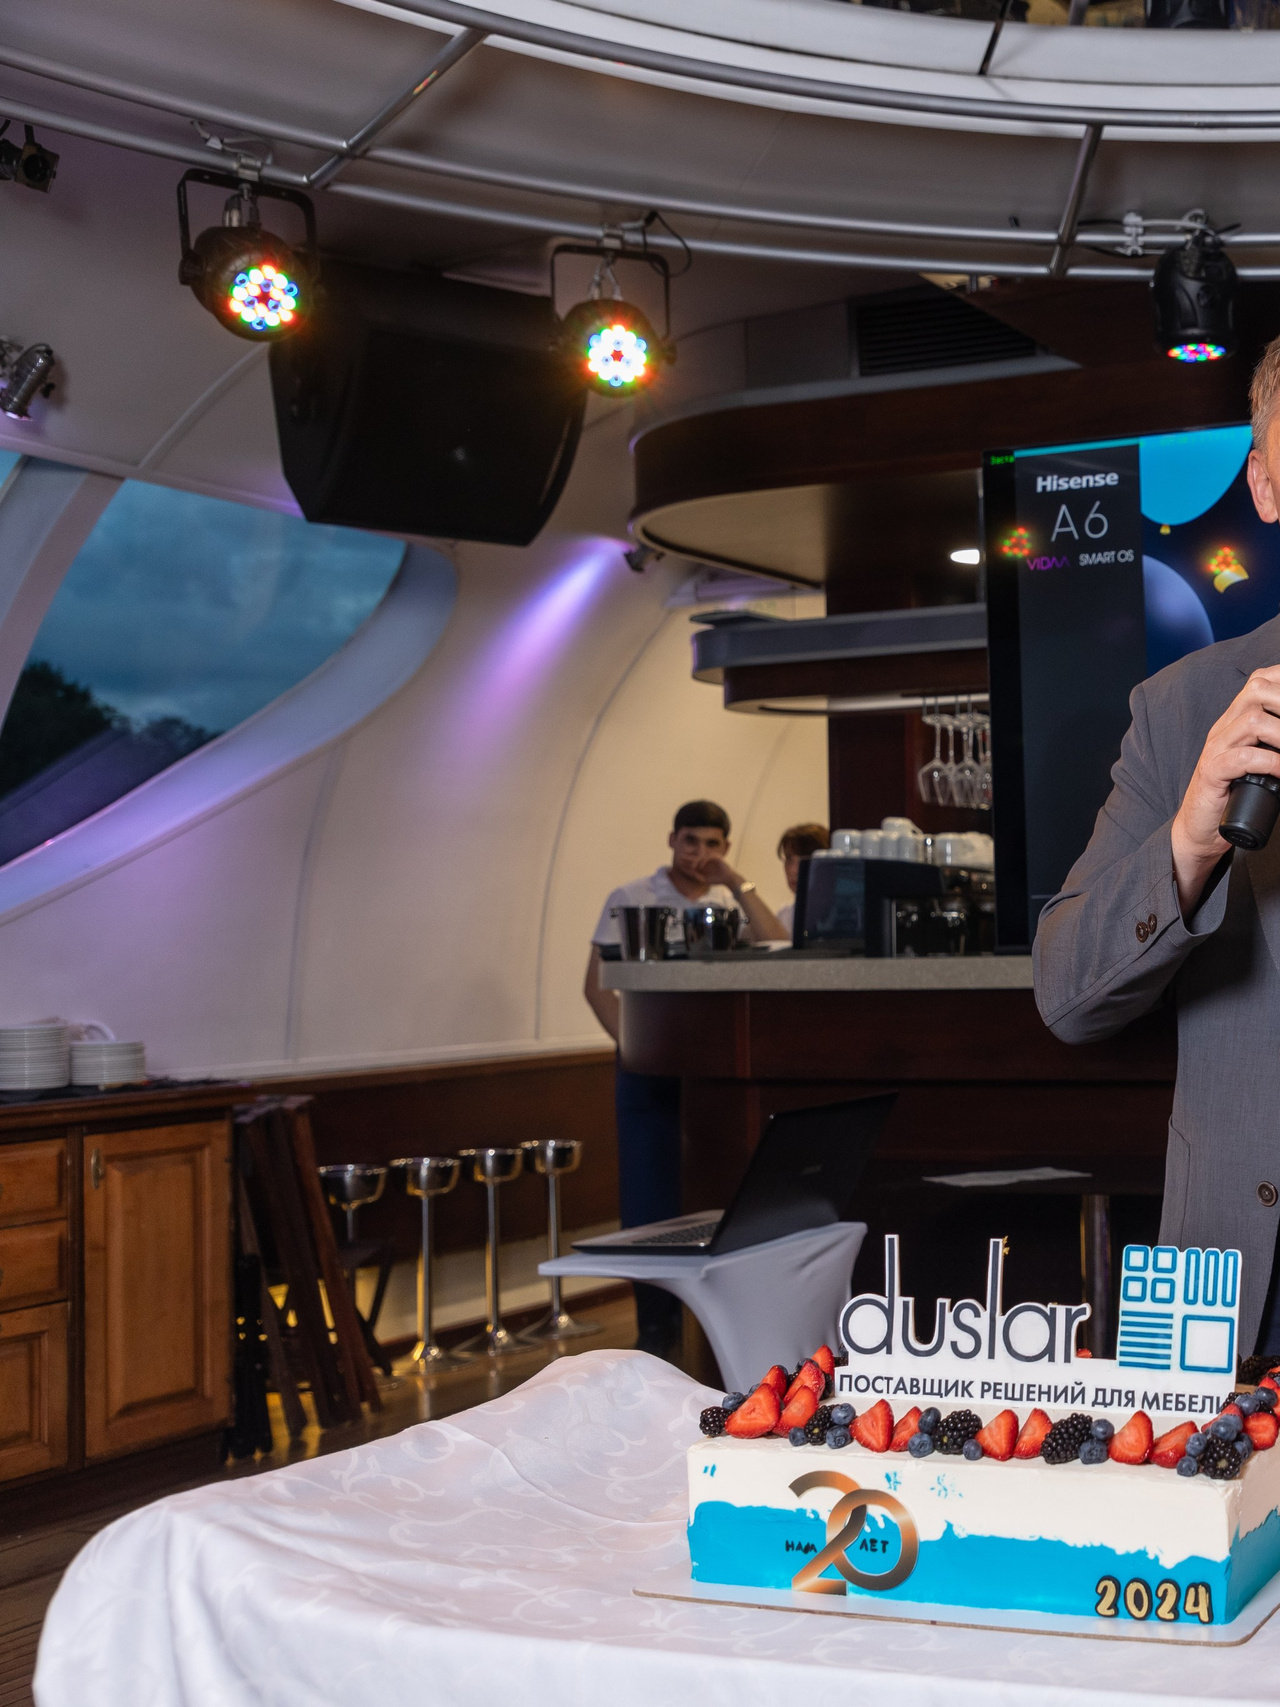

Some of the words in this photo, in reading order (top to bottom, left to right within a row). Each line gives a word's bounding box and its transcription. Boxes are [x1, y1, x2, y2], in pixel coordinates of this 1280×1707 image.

[1036, 471, 1119, 493] Hisense
[1079, 550, 1116, 566] SMART
[1117, 549, 1135, 563] OS
[841, 1236, 1089, 1364] duslar
[839, 1374, 974, 1398] ПОСТАВЩИК
[980, 1380, 1086, 1405] РЕШЕНИЙ
[1091, 1387, 1136, 1408] ДЛЯ
[788, 1470, 919, 1596] 20
[859, 1537, 889, 1554] ЛЕТ
[1095, 1574, 1214, 1624] 2024
